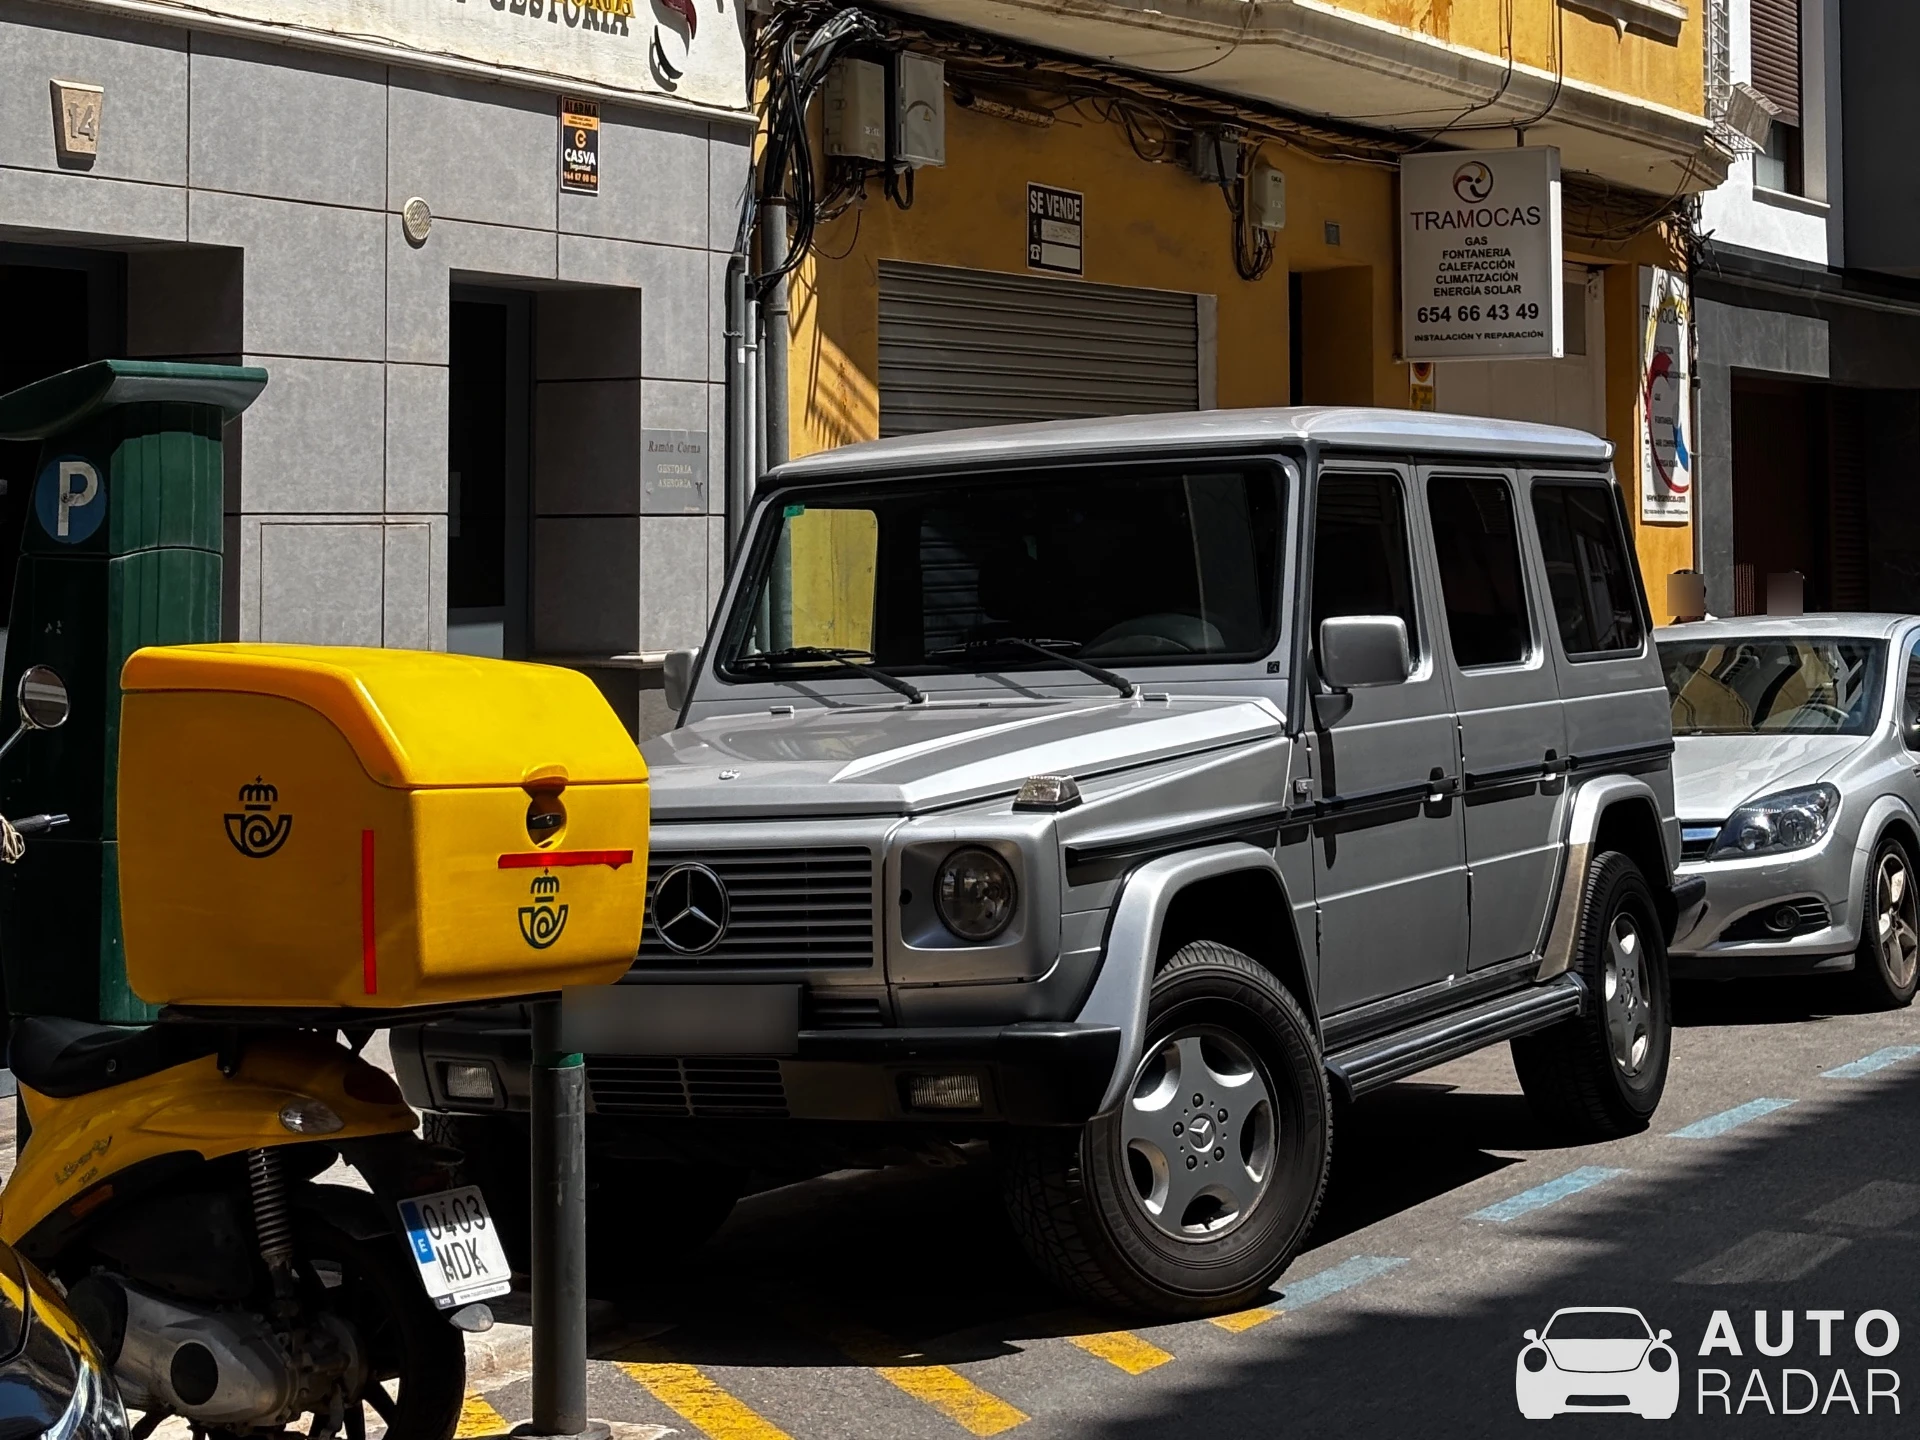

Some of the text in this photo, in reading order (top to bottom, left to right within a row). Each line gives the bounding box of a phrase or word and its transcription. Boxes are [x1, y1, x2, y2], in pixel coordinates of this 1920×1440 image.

[490, 0, 635, 37] STORIA
[564, 99, 597, 117] ALARMA
[68, 101, 95, 141] 14
[565, 148, 596, 165] CASVA
[1030, 190, 1080, 222] SE VENDE
[1410, 206, 1541, 231] TRAMOCAS
[1465, 236, 1488, 246] GAS
[1438, 259, 1515, 272] CALEFACCIÓN
[1435, 271, 1519, 285] CLIMATIZACIÓN
[1433, 284, 1521, 297] ENERGÍA SOLAR
[1417, 303, 1539, 323] 654 66 43 49
[1414, 332, 1474, 342] INSTALACIÓN
[1484, 330, 1544, 339] REPARACIÓN
[57, 461, 99, 537] P
[423, 1195, 486, 1241] 0403
[417, 1238, 428, 1254] E
[435, 1237, 489, 1283] MDK
